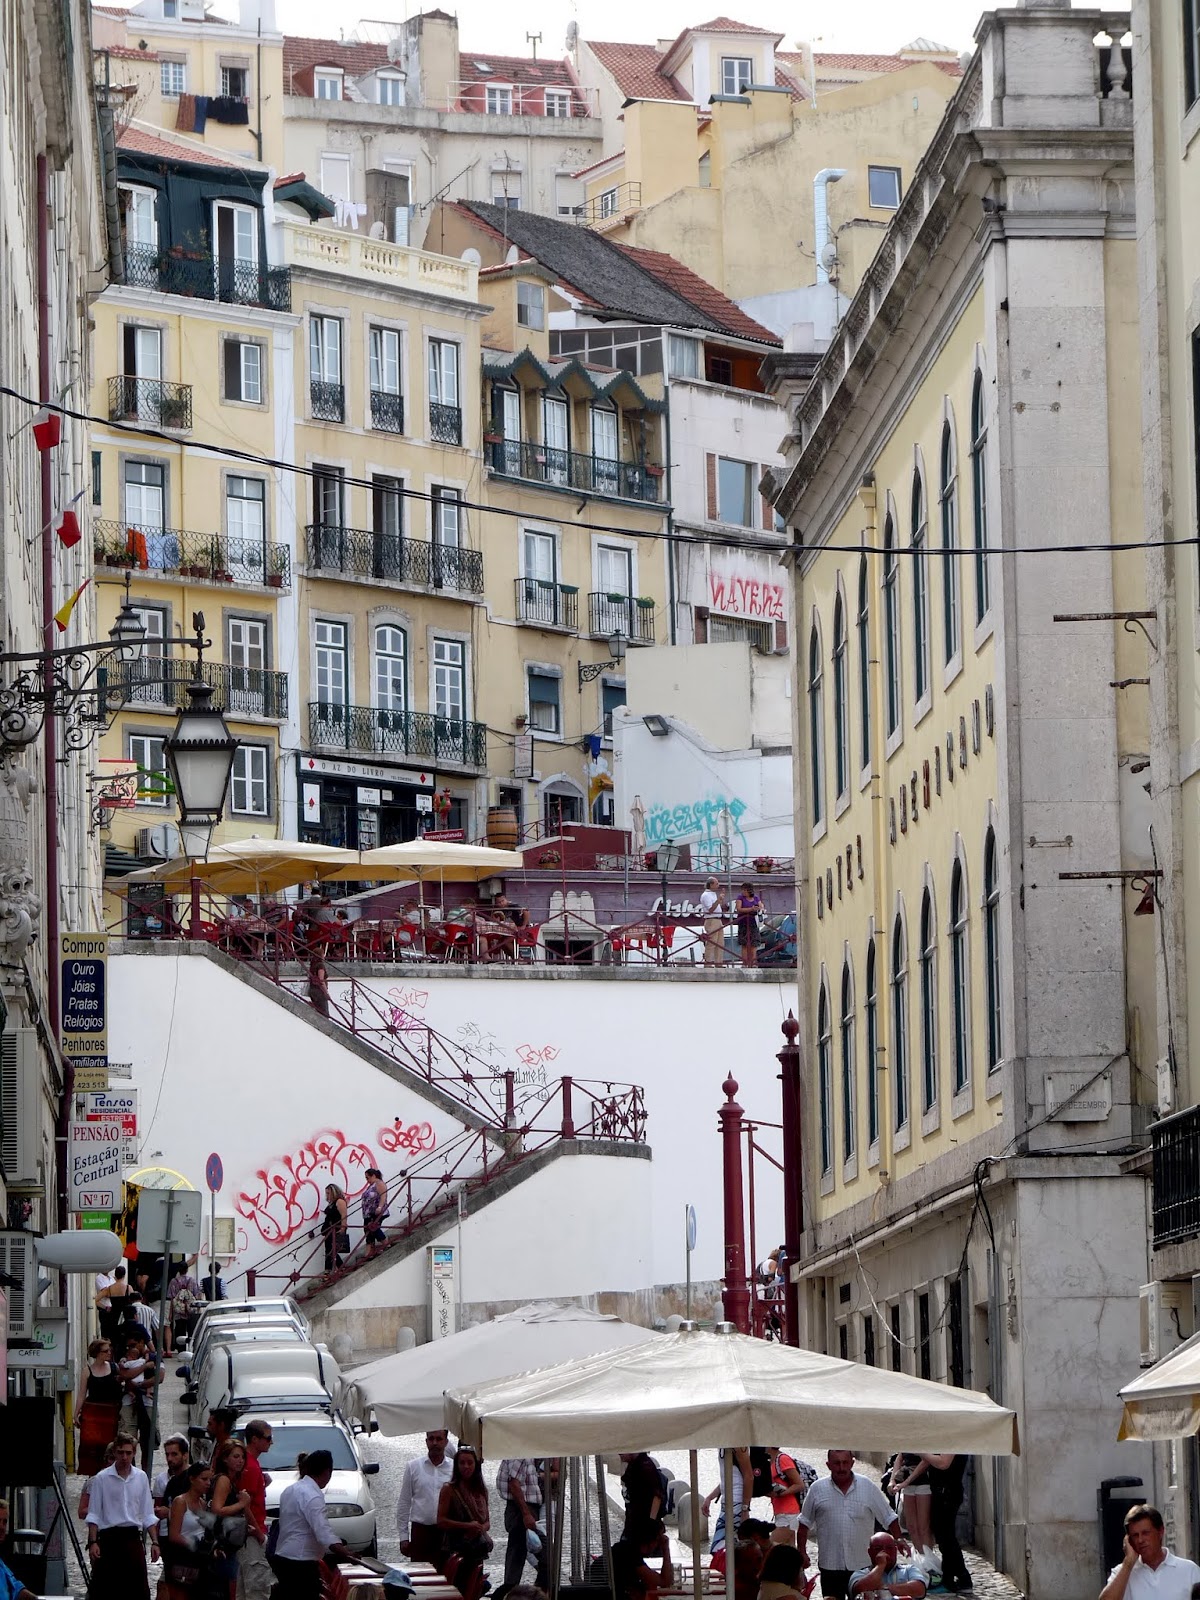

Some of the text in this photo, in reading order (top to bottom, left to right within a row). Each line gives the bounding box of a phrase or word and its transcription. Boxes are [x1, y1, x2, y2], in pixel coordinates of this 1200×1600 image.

[347, 765, 356, 774] DO
[362, 767, 384, 777] LIVRO
[62, 937, 105, 957] Compro
[72, 962, 96, 976] Ouro
[71, 979, 96, 993] Jóias
[68, 997, 99, 1010] Pratas
[63, 1014, 104, 1031] Relógios
[62, 1036, 105, 1052] Penhores
[92, 1081, 106, 1089] 513
[90, 1093, 133, 1107] Pensão
[73, 1123, 119, 1142] PENSÃO
[73, 1147, 119, 1172] Estação
[74, 1160, 119, 1187] Central
[100, 1193, 110, 1206] 17
